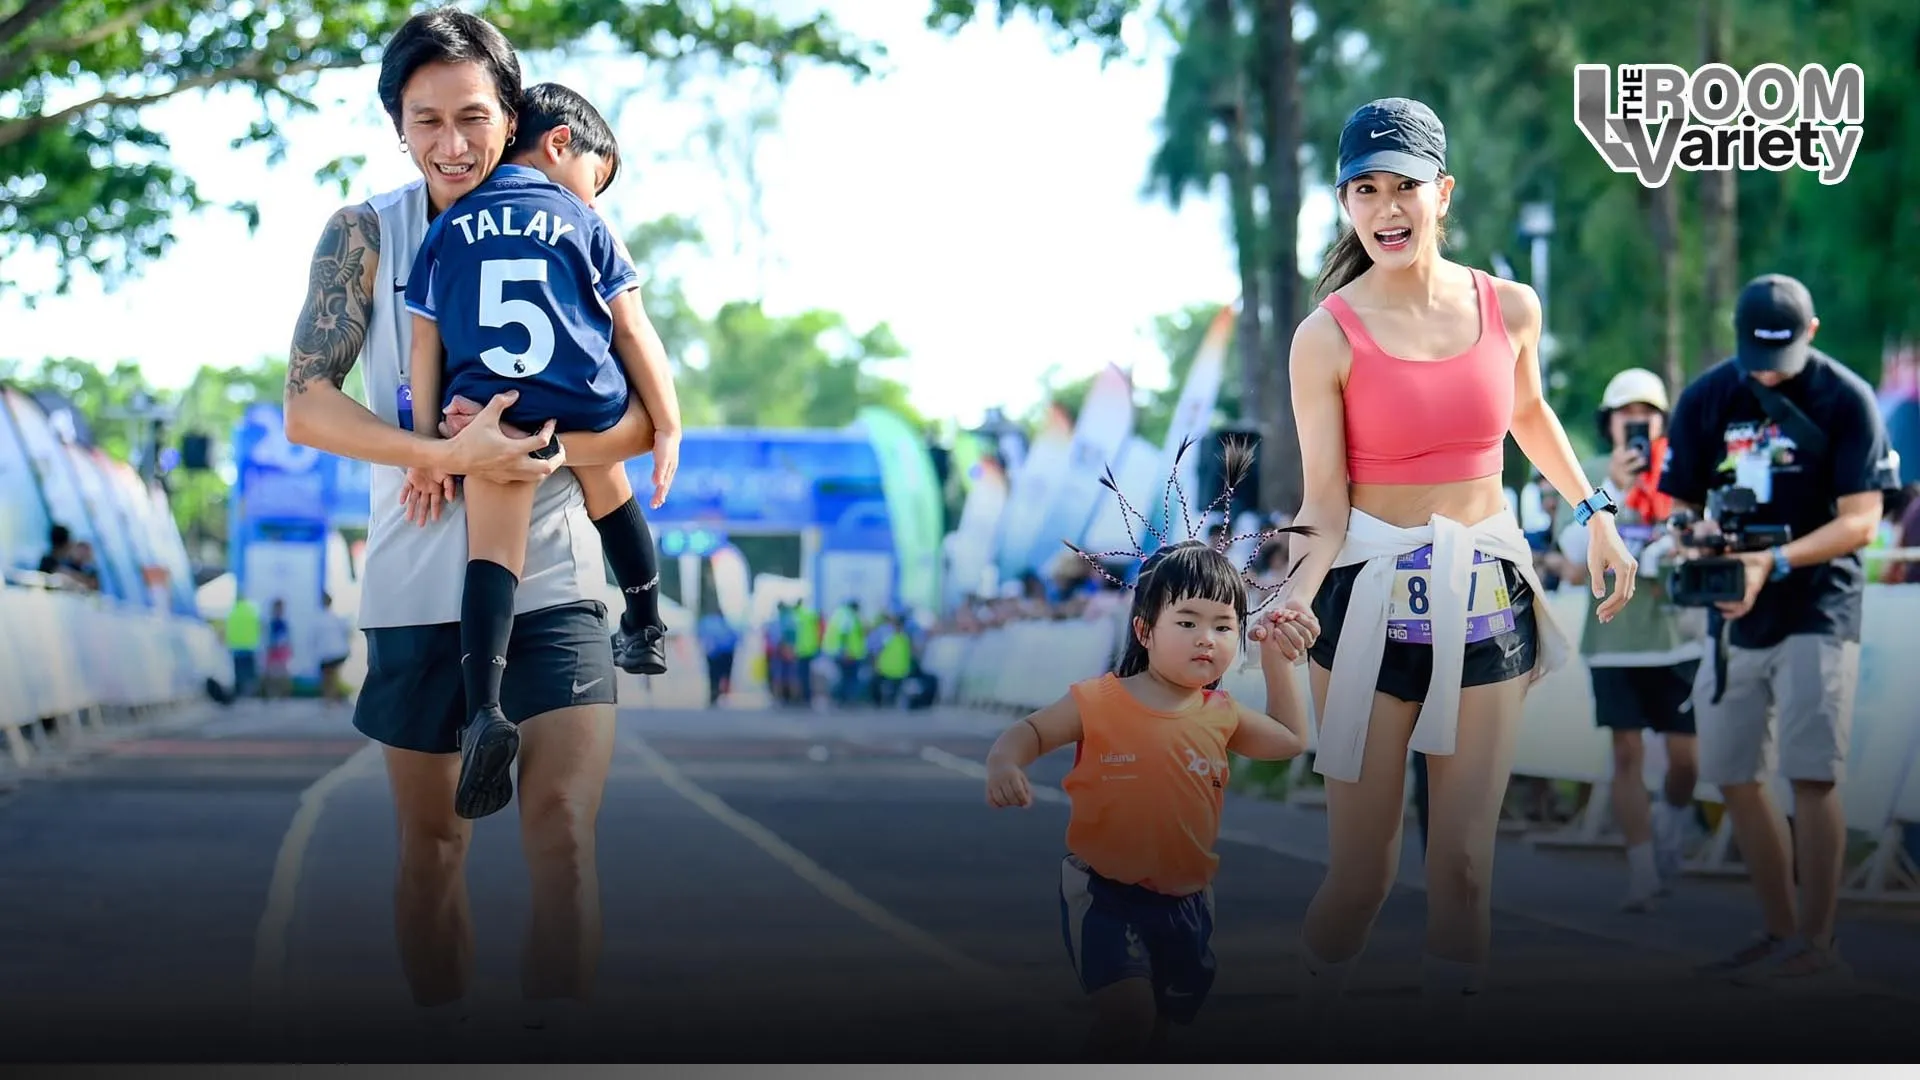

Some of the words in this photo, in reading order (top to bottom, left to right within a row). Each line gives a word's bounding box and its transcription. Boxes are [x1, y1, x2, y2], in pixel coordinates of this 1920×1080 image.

[451, 206, 576, 247] TALAY
[478, 258, 556, 379] 5
[1408, 576, 1429, 614] 8
